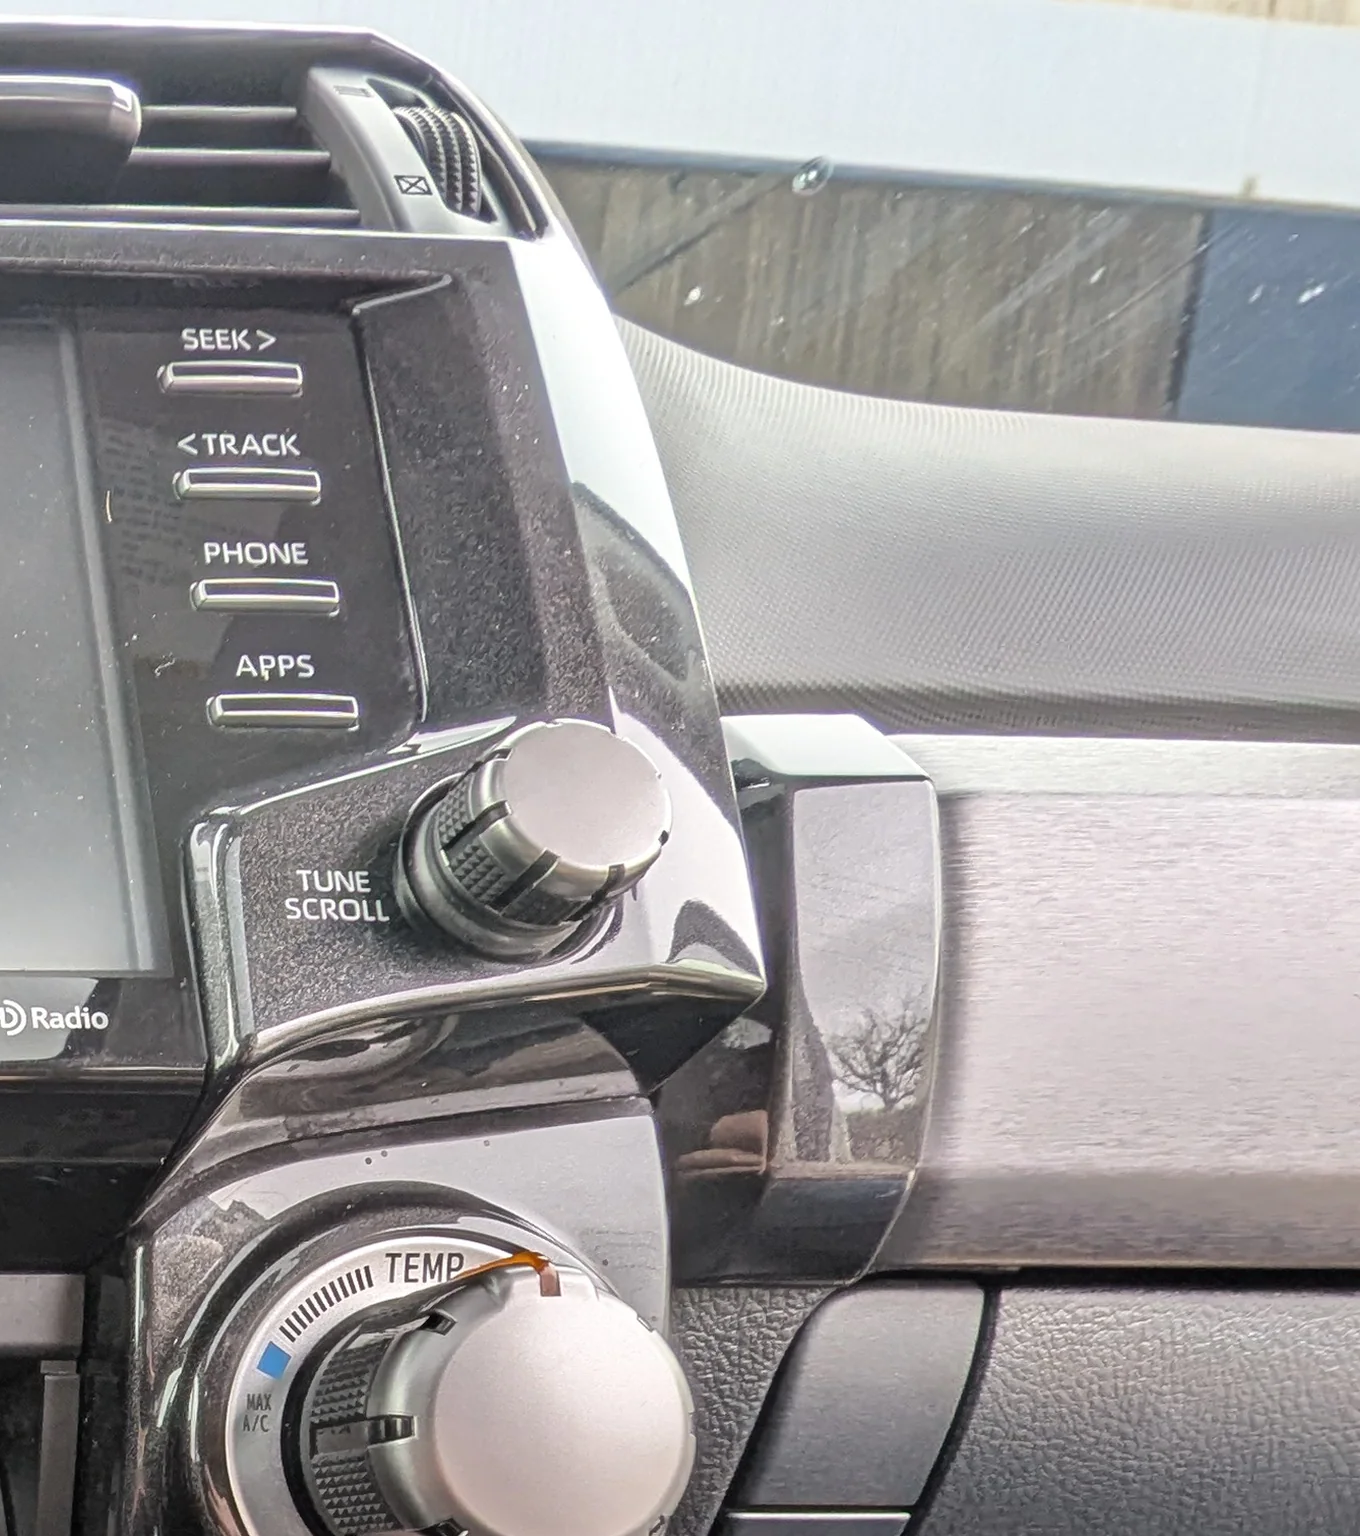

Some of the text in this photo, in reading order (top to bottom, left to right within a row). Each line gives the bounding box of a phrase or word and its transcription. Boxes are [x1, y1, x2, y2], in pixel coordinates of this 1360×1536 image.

[204, 541, 308, 565] PHONE
[236, 654, 315, 678] APPS
[296, 869, 371, 894] TUNE
[285, 898, 389, 923] SCROLL
[30, 1005, 109, 1030] Radio
[385, 1252, 465, 1284] TEMP
[246, 1393, 272, 1412] MAX
[243, 1414, 270, 1433] A/C
